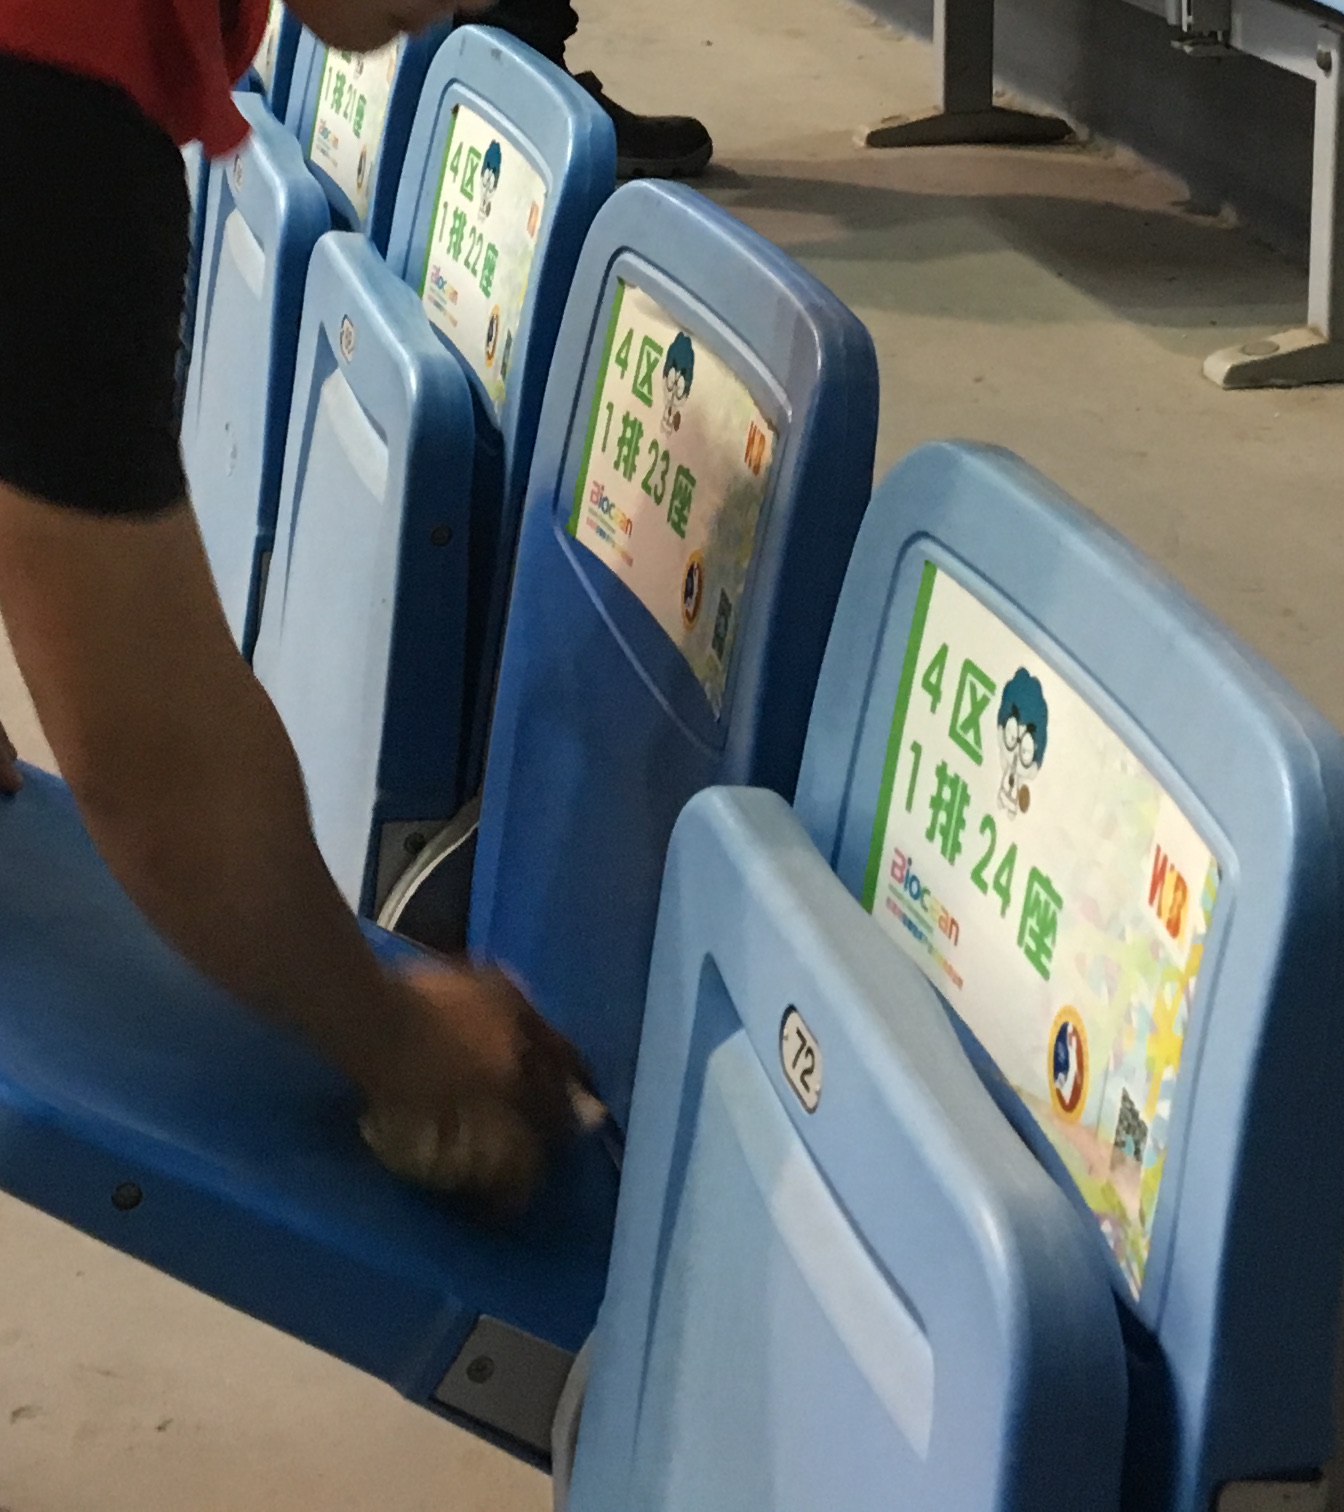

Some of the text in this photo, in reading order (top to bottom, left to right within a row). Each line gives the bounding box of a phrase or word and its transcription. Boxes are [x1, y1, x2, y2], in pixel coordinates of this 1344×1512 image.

[449, 141, 482, 202] 4区
[439, 201, 499, 299] 1排22座
[615, 327, 664, 408] 4区
[600, 401, 697, 540] 1排23座
[921, 642, 997, 767] 4区
[904, 740, 1064, 982] 1排24座
[791, 1027, 816, 1094] 72
